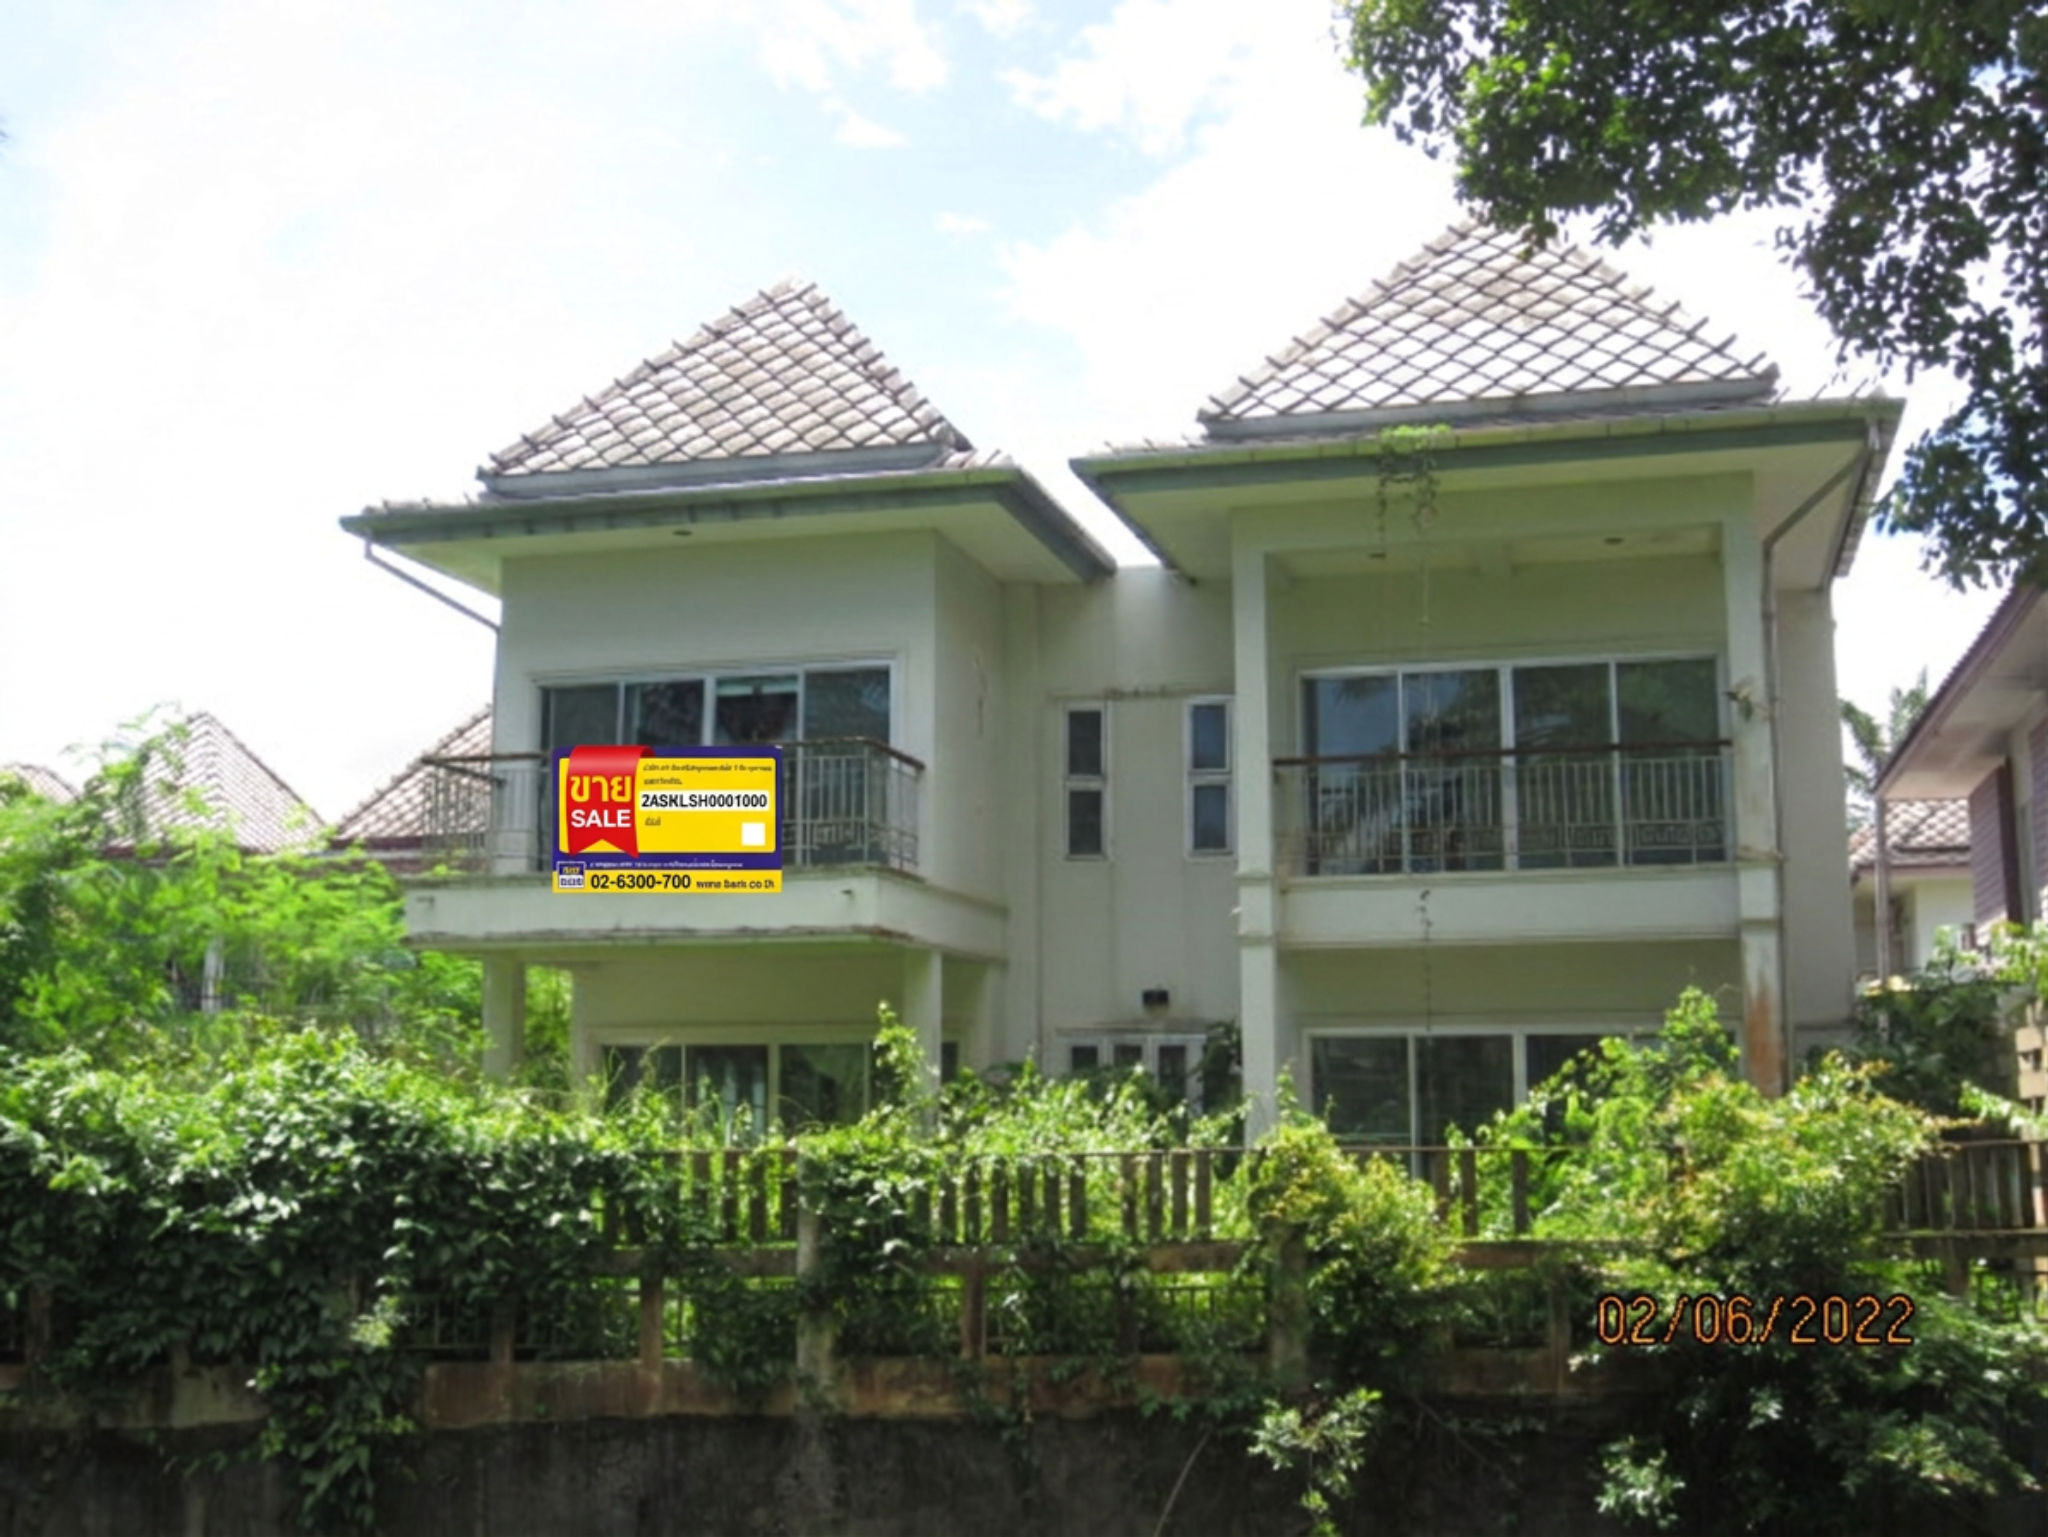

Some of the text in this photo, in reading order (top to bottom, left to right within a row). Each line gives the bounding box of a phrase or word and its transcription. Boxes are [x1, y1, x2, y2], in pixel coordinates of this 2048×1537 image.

[570, 775, 631, 802] ขาย
[571, 809, 631, 828] SALE
[591, 874, 691, 889] 02-6300-700
